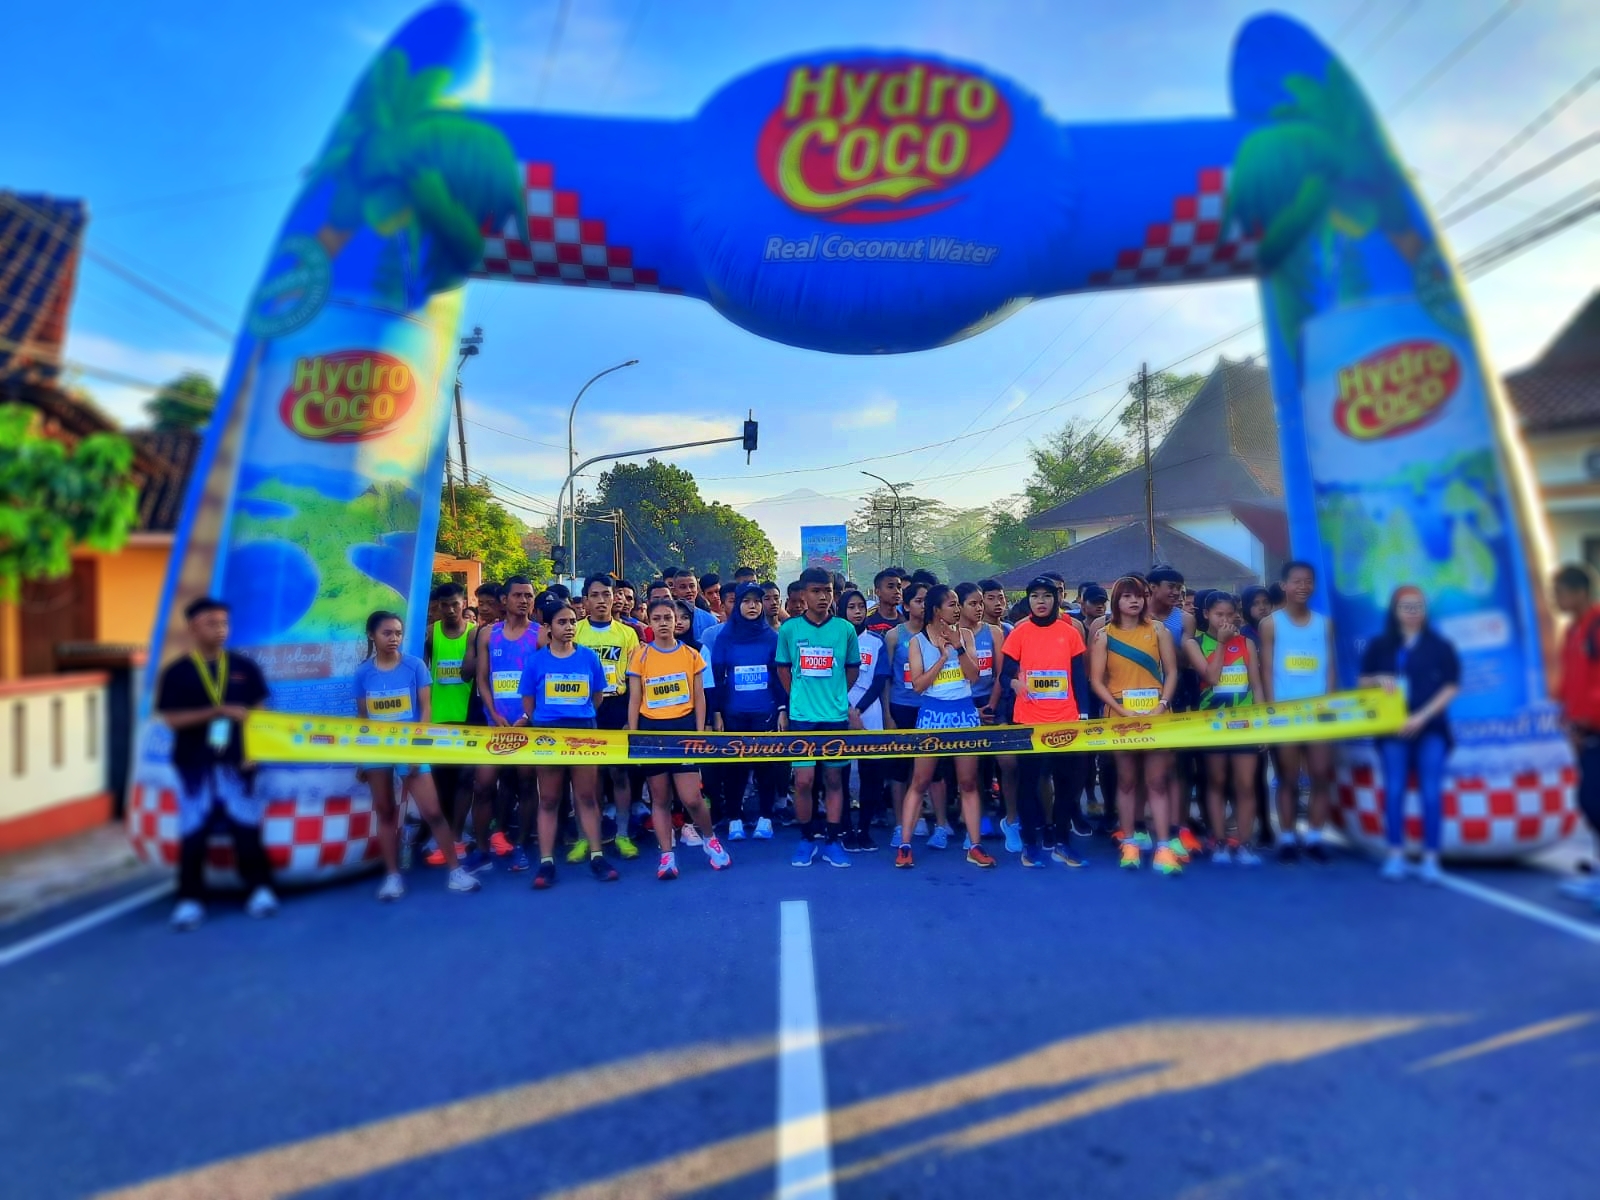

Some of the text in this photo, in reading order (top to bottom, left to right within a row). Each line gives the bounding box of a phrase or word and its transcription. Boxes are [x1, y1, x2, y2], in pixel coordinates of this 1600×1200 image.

[785, 64, 998, 125] Hydro
[766, 235, 998, 264] Real Coconut Water
[293, 356, 412, 395] Hydro
[1338, 342, 1453, 402] Hydro
[283, 646, 326, 665] Island
[603, 646, 620, 661] 7K
[805, 657, 827, 666] P0005
[741, 673, 762, 682] F0004
[1034, 679, 1060, 688] U0045
[554, 683, 581, 693] U0047
[653, 683, 680, 695] U0046
[1129, 698, 1154, 708] U0023
[491, 732, 526, 744] Hydro
[1112, 736, 1156, 746] DRAGON
[678, 739, 718, 755] The
[722, 739, 785, 757] Spirit
